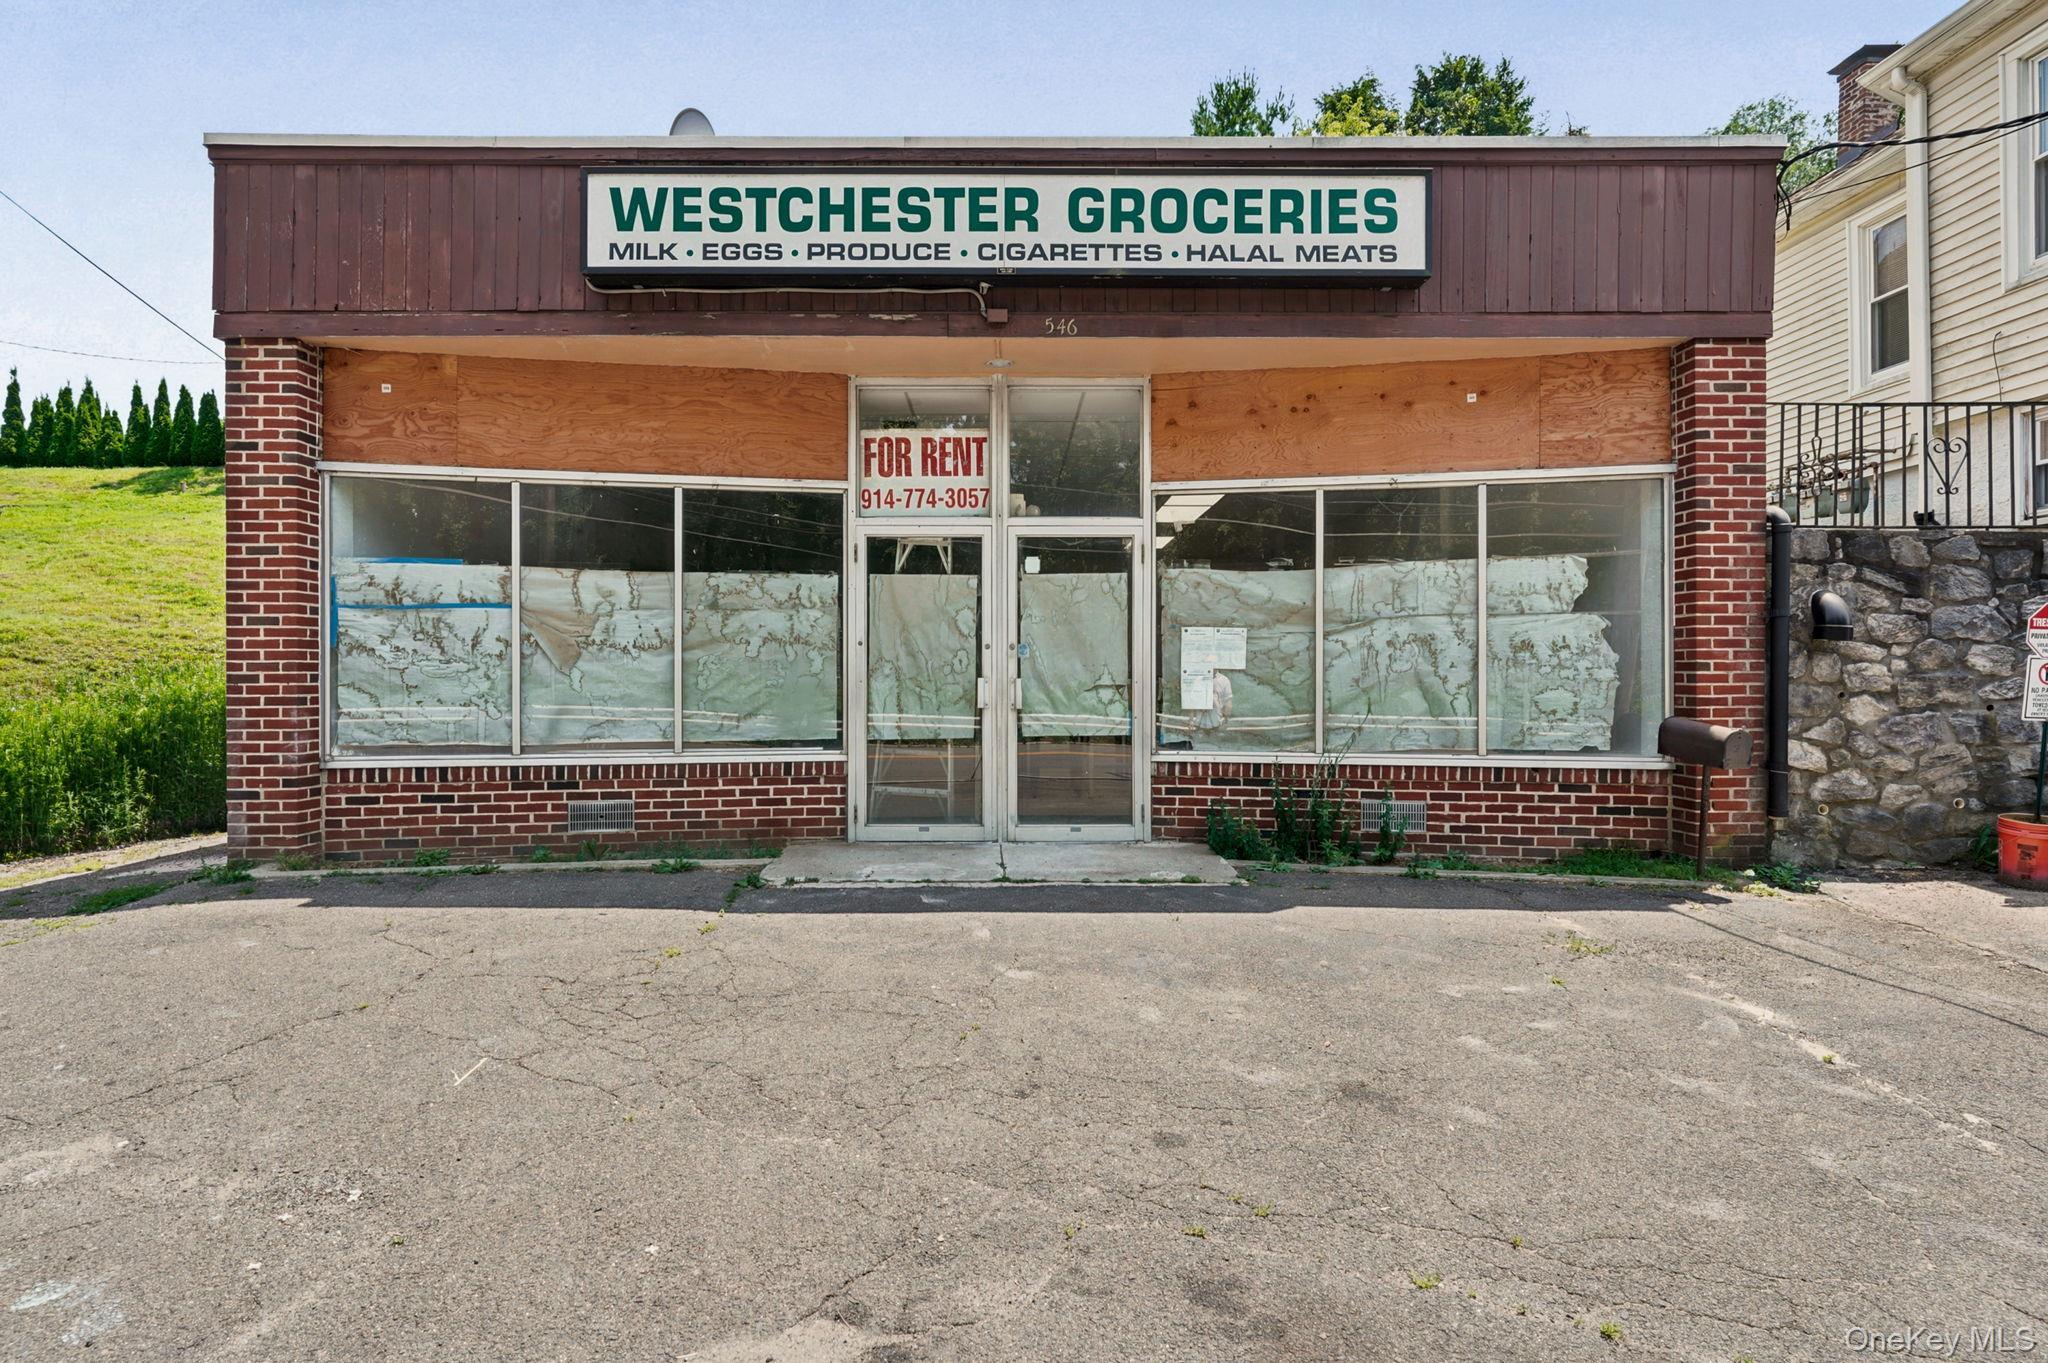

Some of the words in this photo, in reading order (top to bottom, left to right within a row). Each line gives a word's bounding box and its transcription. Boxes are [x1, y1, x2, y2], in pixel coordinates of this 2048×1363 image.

[609, 186, 1040, 234] WESTCHESTER
[1067, 187, 1399, 235] GROCERIES
[608, 242, 679, 261] MILK
[702, 242, 784, 261] EGGS
[806, 242, 951, 261] PRODUCE
[977, 243, 1163, 262] CIGARETTES
[1186, 244, 1285, 262] HALAL
[1295, 244, 1398, 263] MEATS
[1044, 317, 1078, 337] 546
[864, 436, 912, 477] FOR
[921, 436, 988, 477] RENT
[861, 487, 990, 509] 914-774-3057
